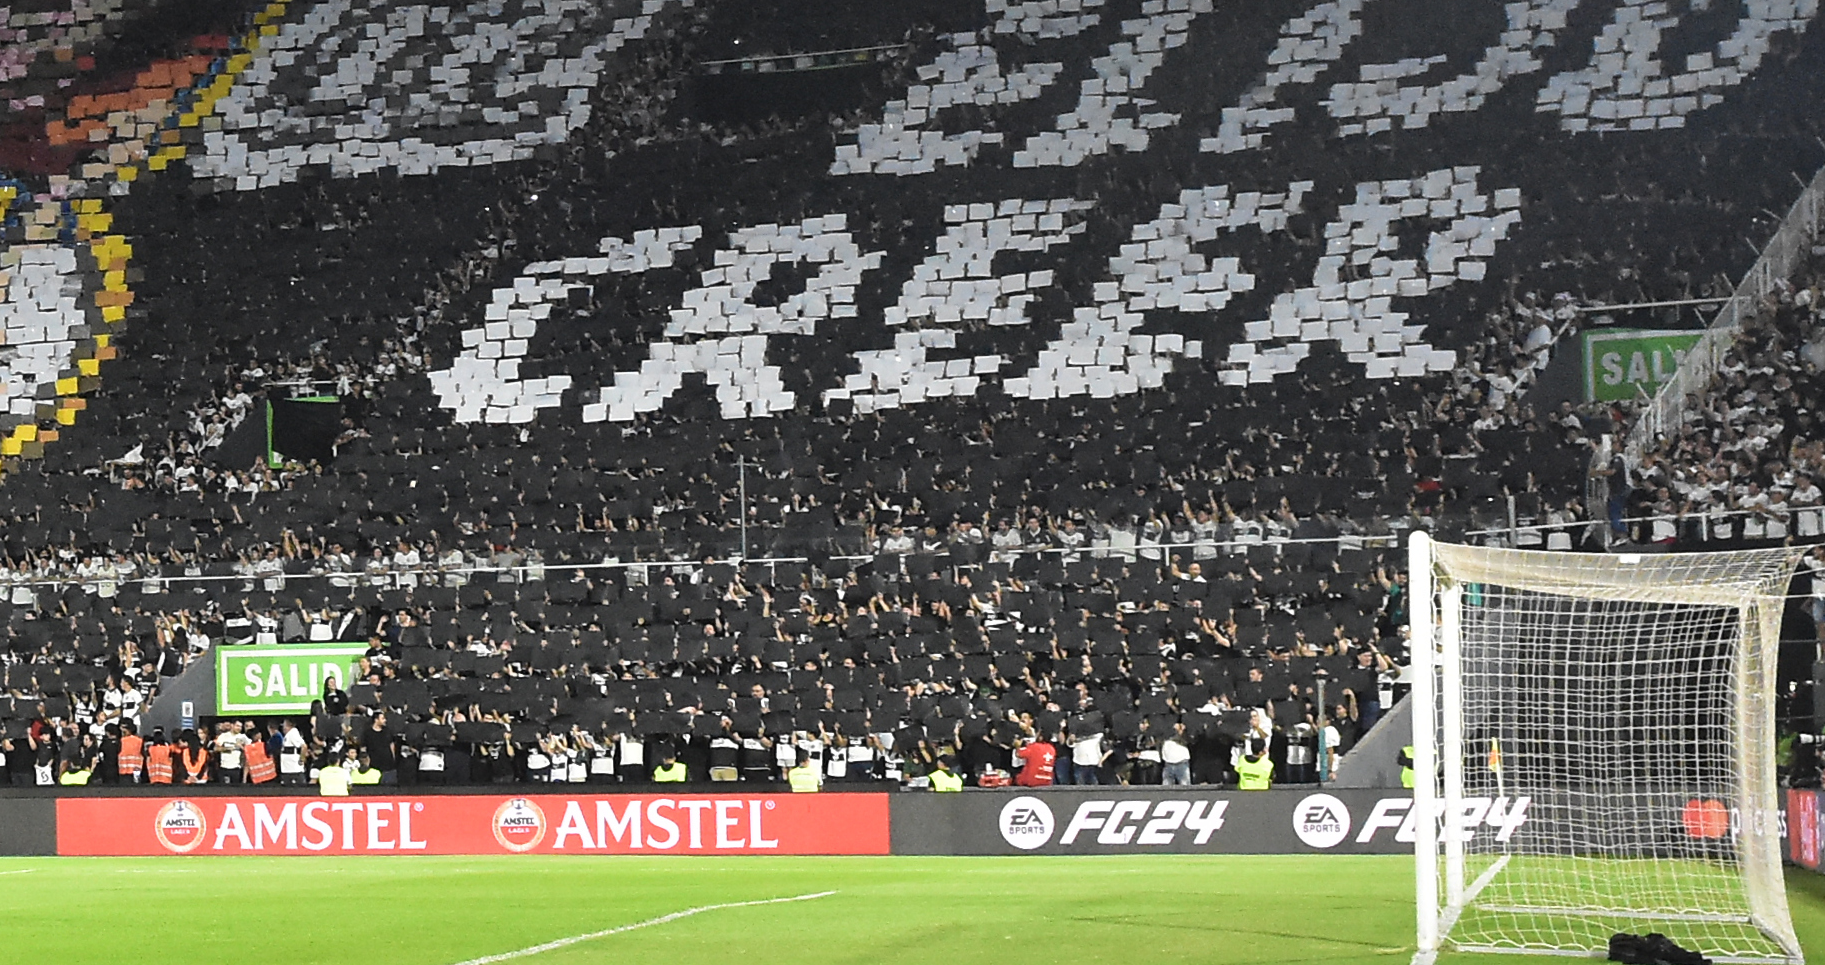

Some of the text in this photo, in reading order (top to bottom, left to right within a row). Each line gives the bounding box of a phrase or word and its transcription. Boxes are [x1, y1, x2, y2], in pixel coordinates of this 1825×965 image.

[427, 166, 1521, 423] CREER
[244, 662, 351, 697] SALID
[212, 801, 427, 850] AMSTEL
[553, 798, 779, 849] AMSTEL
[1010, 808, 1043, 825] EA
[1303, 823, 1341, 833] SPORTS
[1304, 805, 1339, 824] EA
[1009, 825, 1045, 835] SPORTS
